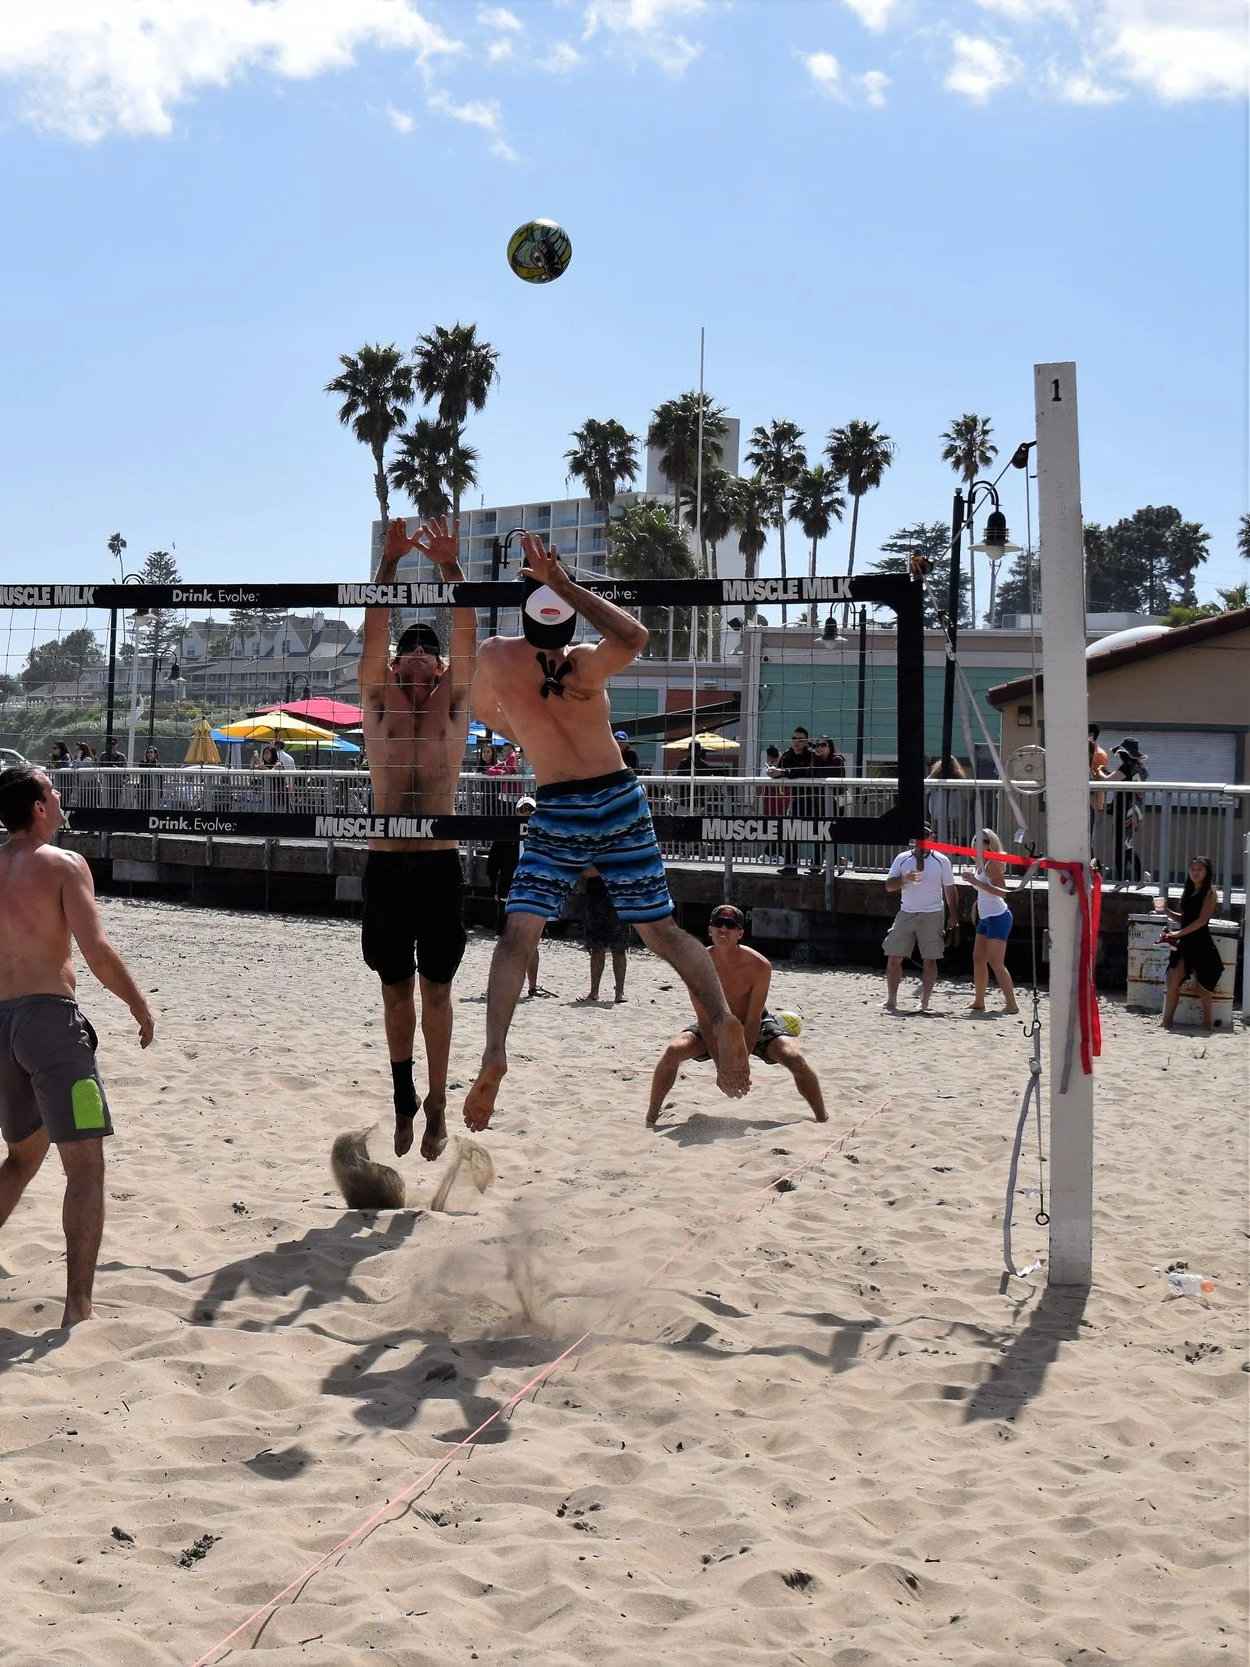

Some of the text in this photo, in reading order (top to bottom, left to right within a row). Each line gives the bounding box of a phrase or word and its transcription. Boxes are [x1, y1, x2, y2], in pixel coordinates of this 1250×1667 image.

[1051, 379, 1062, 401] 1
[54, 585, 94, 605] MILK
[337, 584, 456, 605] MUSCLE MILK
[723, 578, 851, 602] MUSCLE MILK
[315, 816, 434, 838] MUSCLE MILK
[701, 819, 831, 842] MUSCLE MILK
